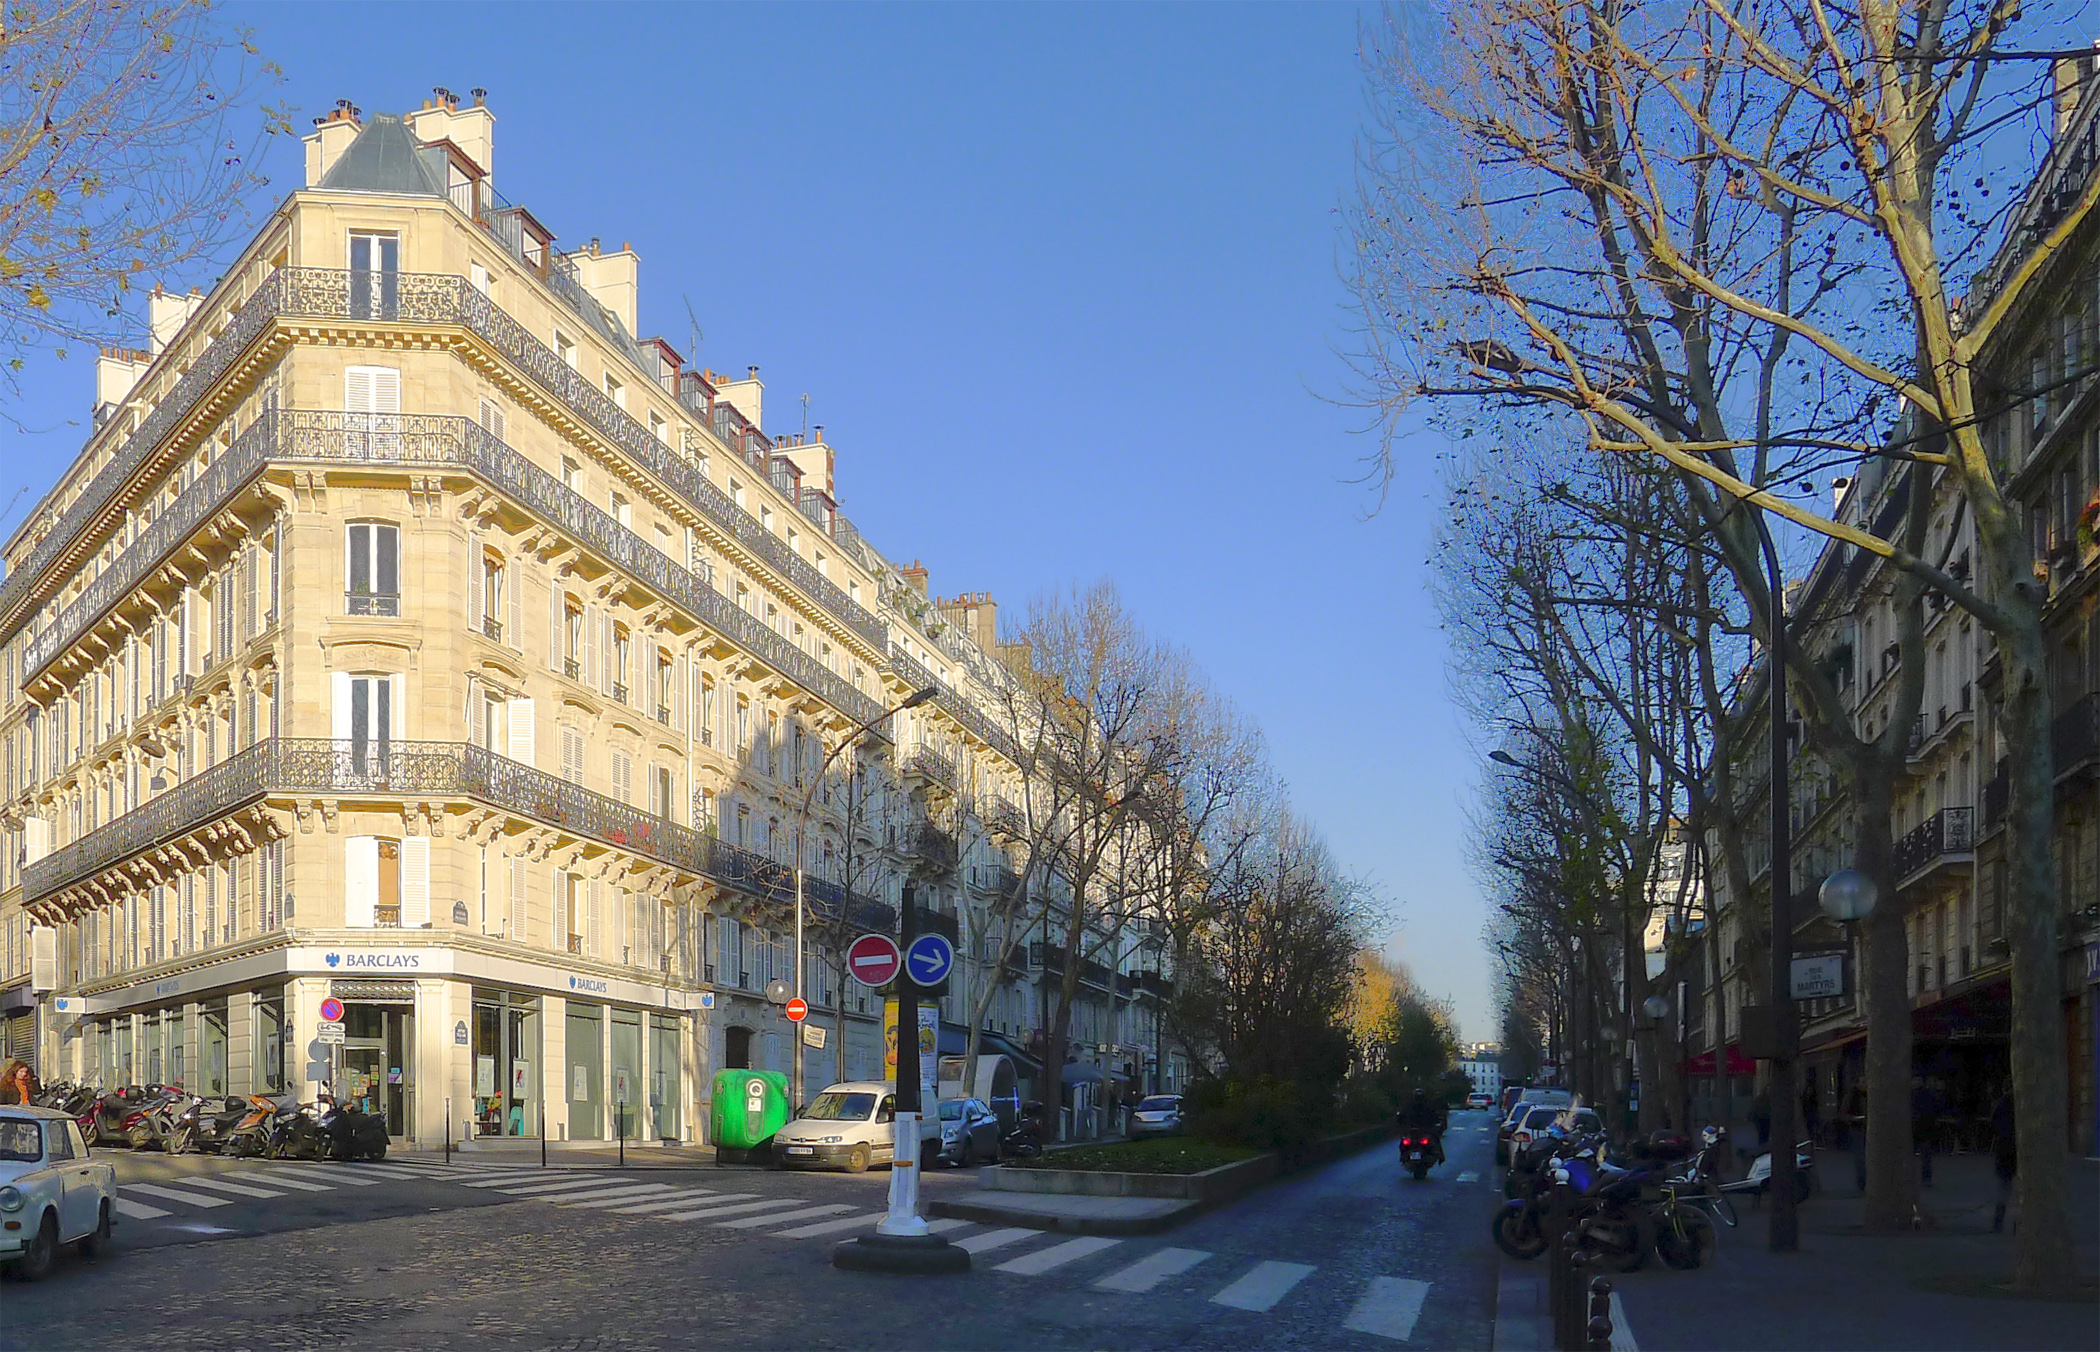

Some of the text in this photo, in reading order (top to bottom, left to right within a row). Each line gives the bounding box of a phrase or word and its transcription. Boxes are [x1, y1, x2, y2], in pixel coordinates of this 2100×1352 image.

[346, 954, 420, 968] BARCLAYS
[577, 978, 607, 993] BARCLAYS
[1797, 978, 1835, 992] MARTYRS
